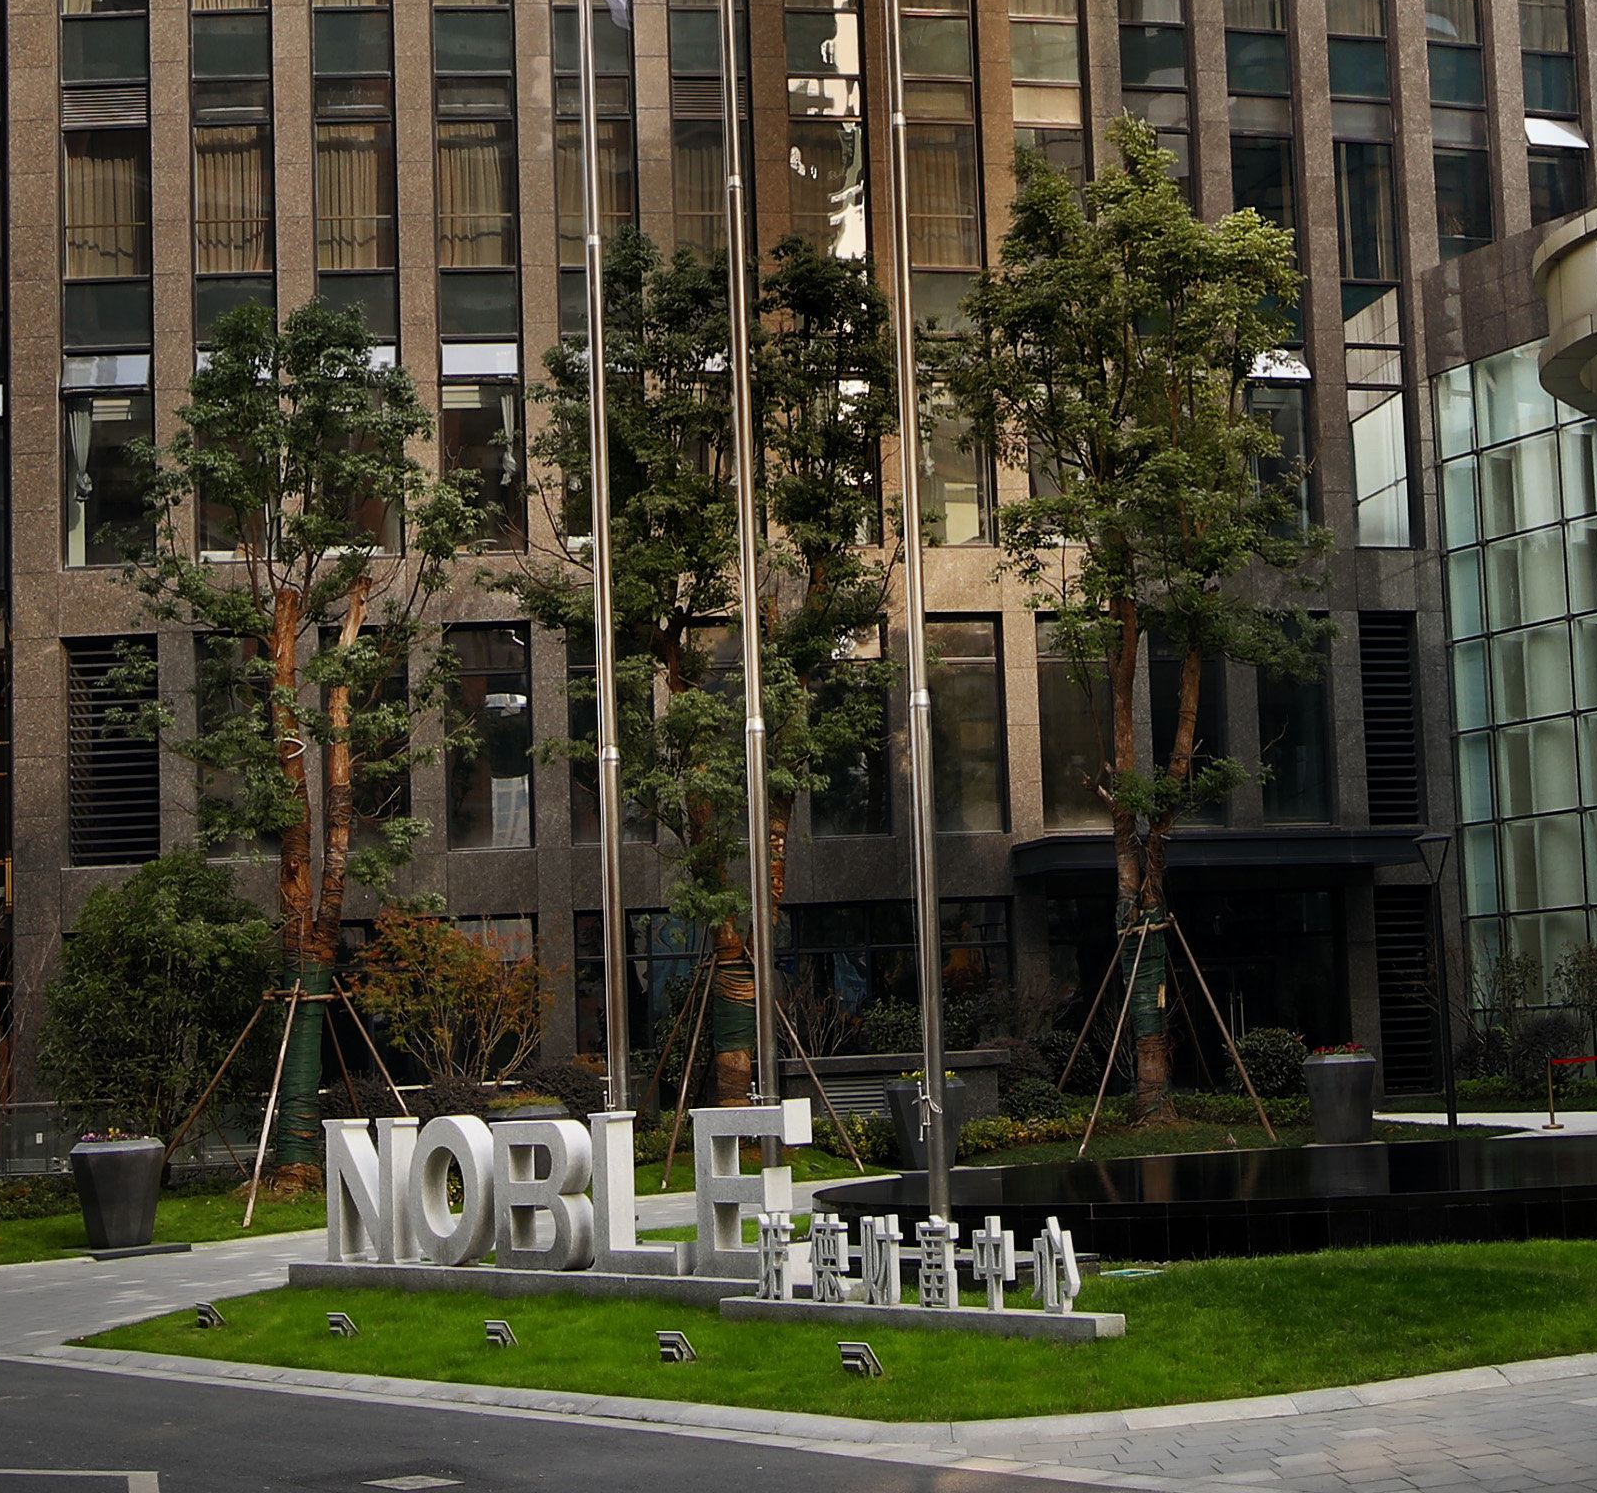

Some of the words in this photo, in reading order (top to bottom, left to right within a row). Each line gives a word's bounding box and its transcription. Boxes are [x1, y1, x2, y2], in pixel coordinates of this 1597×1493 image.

[323, 1098, 812, 1278] NOBLE
[756, 1213, 1081, 1313] 诺德财富中心
